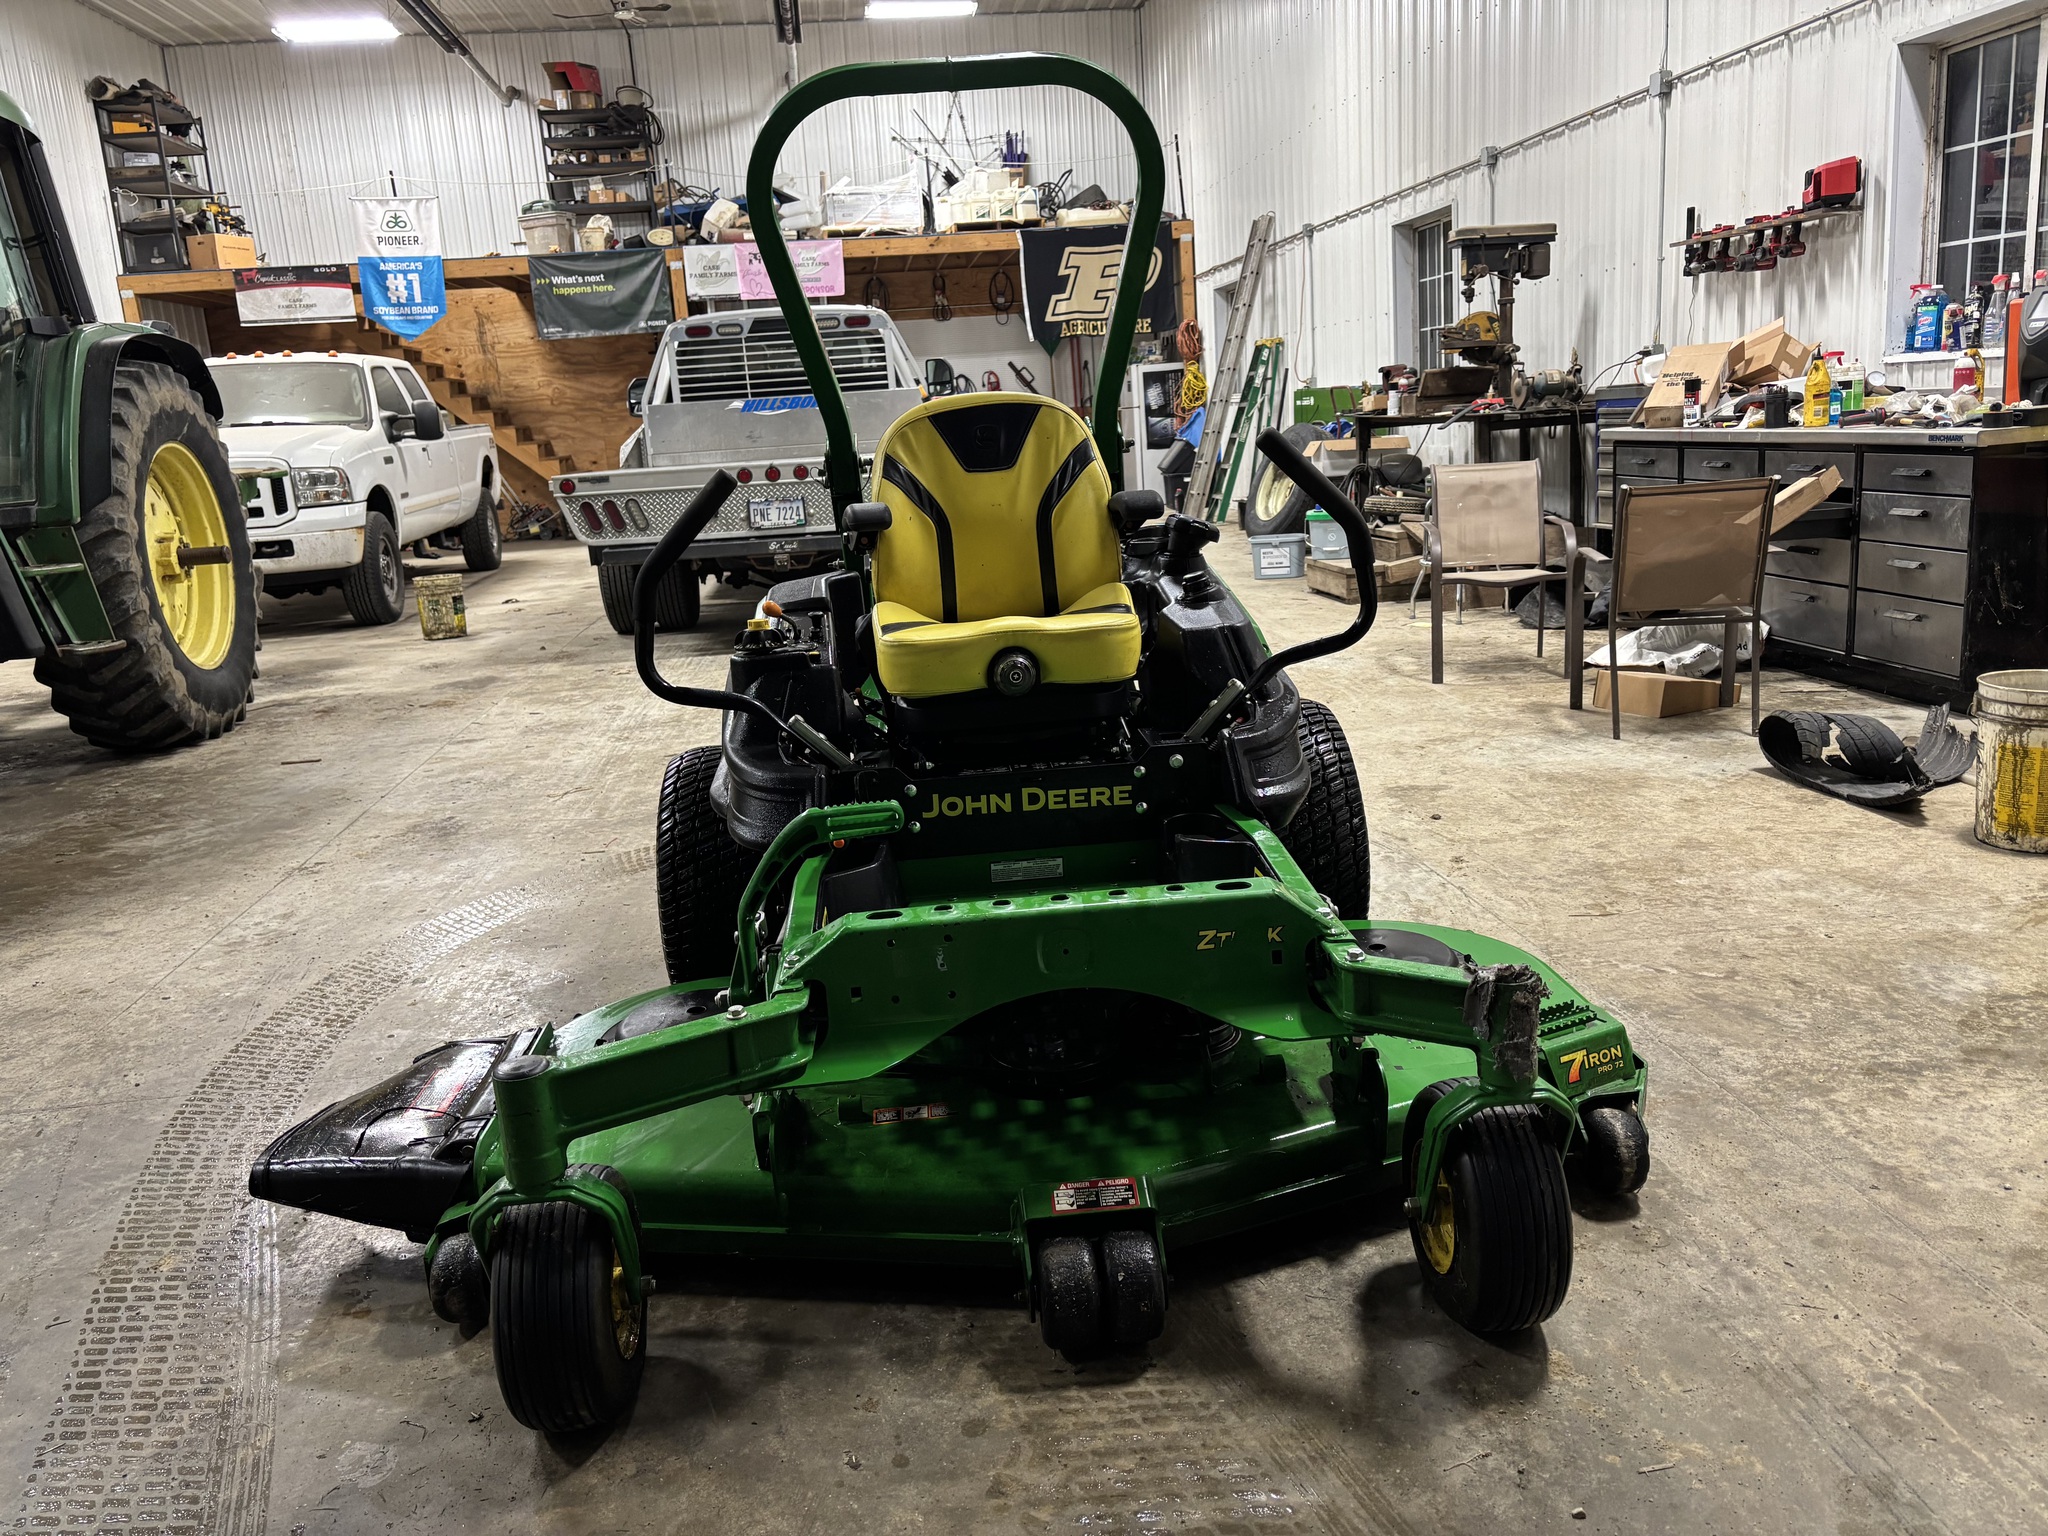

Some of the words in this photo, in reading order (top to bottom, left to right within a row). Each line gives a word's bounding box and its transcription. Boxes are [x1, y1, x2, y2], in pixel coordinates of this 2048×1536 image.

[377, 235, 420, 246] PIONEER
[380, 262, 423, 271] AMERICA'S
[551, 275, 584, 285] What's
[584, 273, 605, 283] next
[689, 271, 714, 279] FAMILY
[386, 273, 422, 304] #1
[553, 285, 592, 296] happens
[592, 284, 616, 293] here.
[804, 284, 836, 294] PONSOR
[373, 306, 411, 315] SOYBEAN
[411, 305, 439, 315] BRAND
[648, 319, 668, 327] PIONEER
[1060, 317, 1152, 338] AGRICURE
[1662, 371, 1695, 379] Helping
[1928, 434, 1964, 443] BENCHMARK
[753, 507, 773, 523] PNE
[775, 506, 802, 522] 7224
[922, 793, 1012, 819] JOHN
[1021, 785, 1133, 812] DEERE
[1597, 1063, 1613, 1075] PRO
[1614, 1060, 1625, 1069] 72
[1067, 1181, 1090, 1189] DANGER
[1105, 1178, 1130, 1186] PELIGRO
